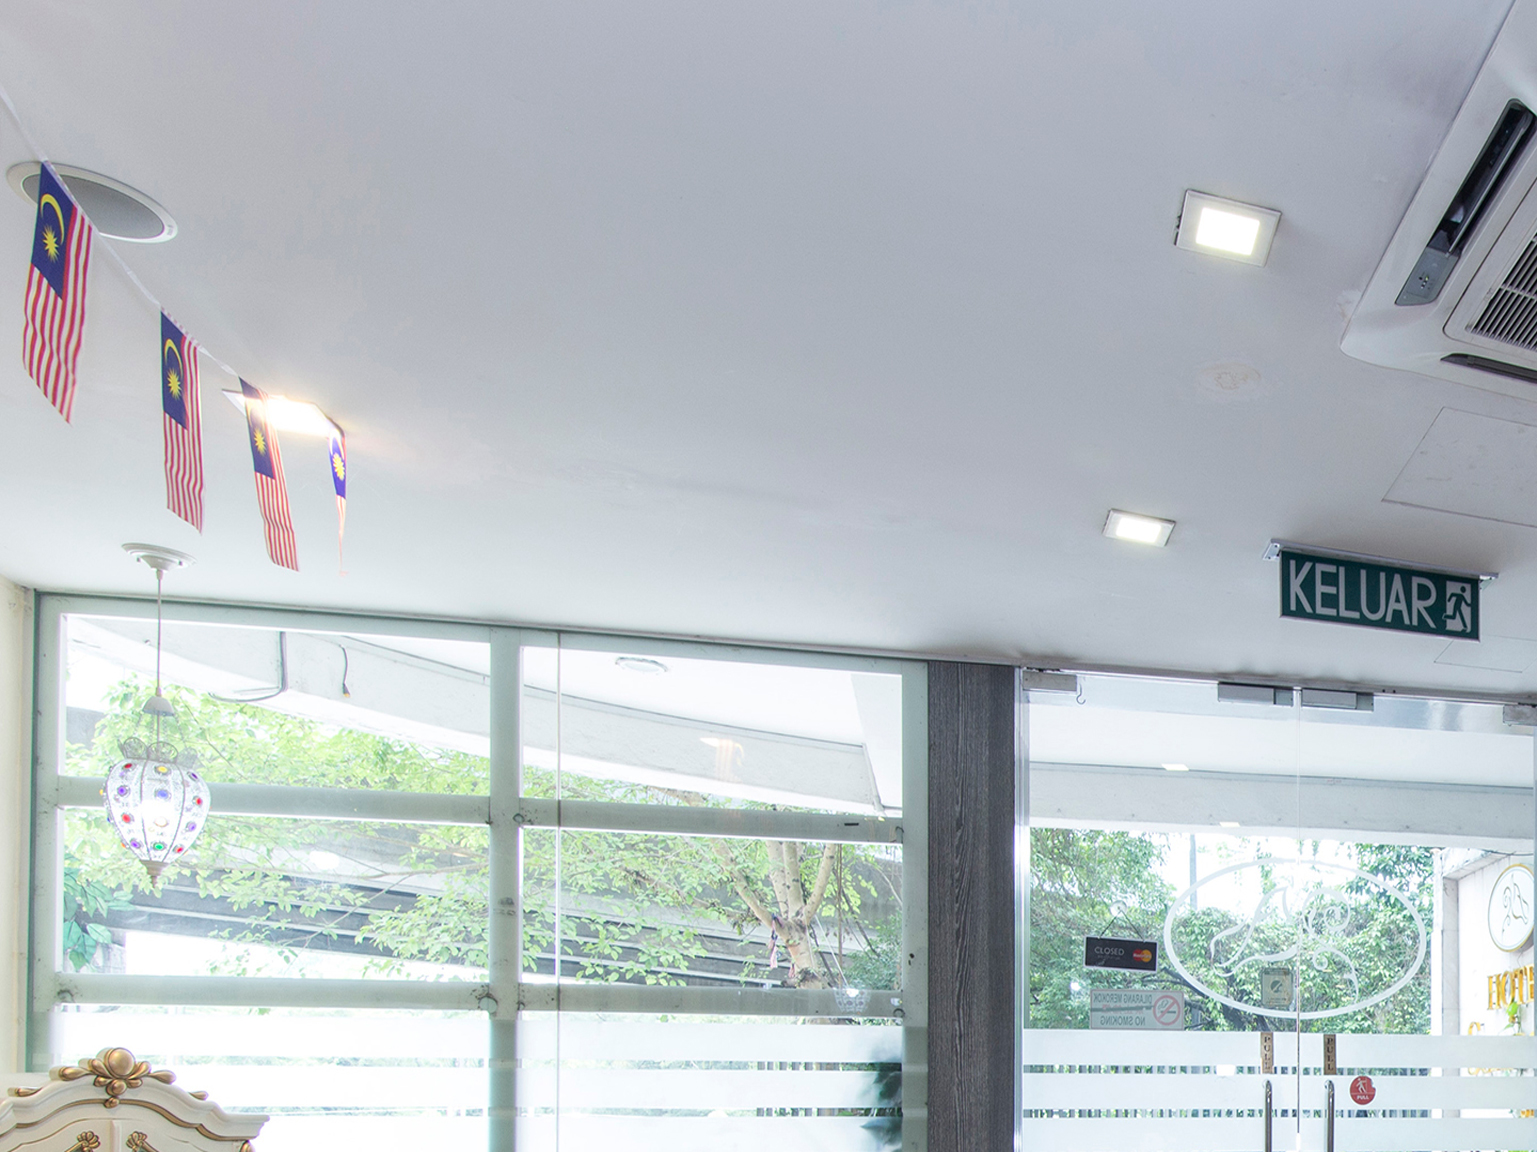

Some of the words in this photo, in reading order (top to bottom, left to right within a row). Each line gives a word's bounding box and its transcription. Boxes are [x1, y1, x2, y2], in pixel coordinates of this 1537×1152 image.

[1290, 559, 1437, 629] KELUAR
[1094, 946, 1125, 956] CLOSED
[1326, 1037, 1334, 1071] PULL
